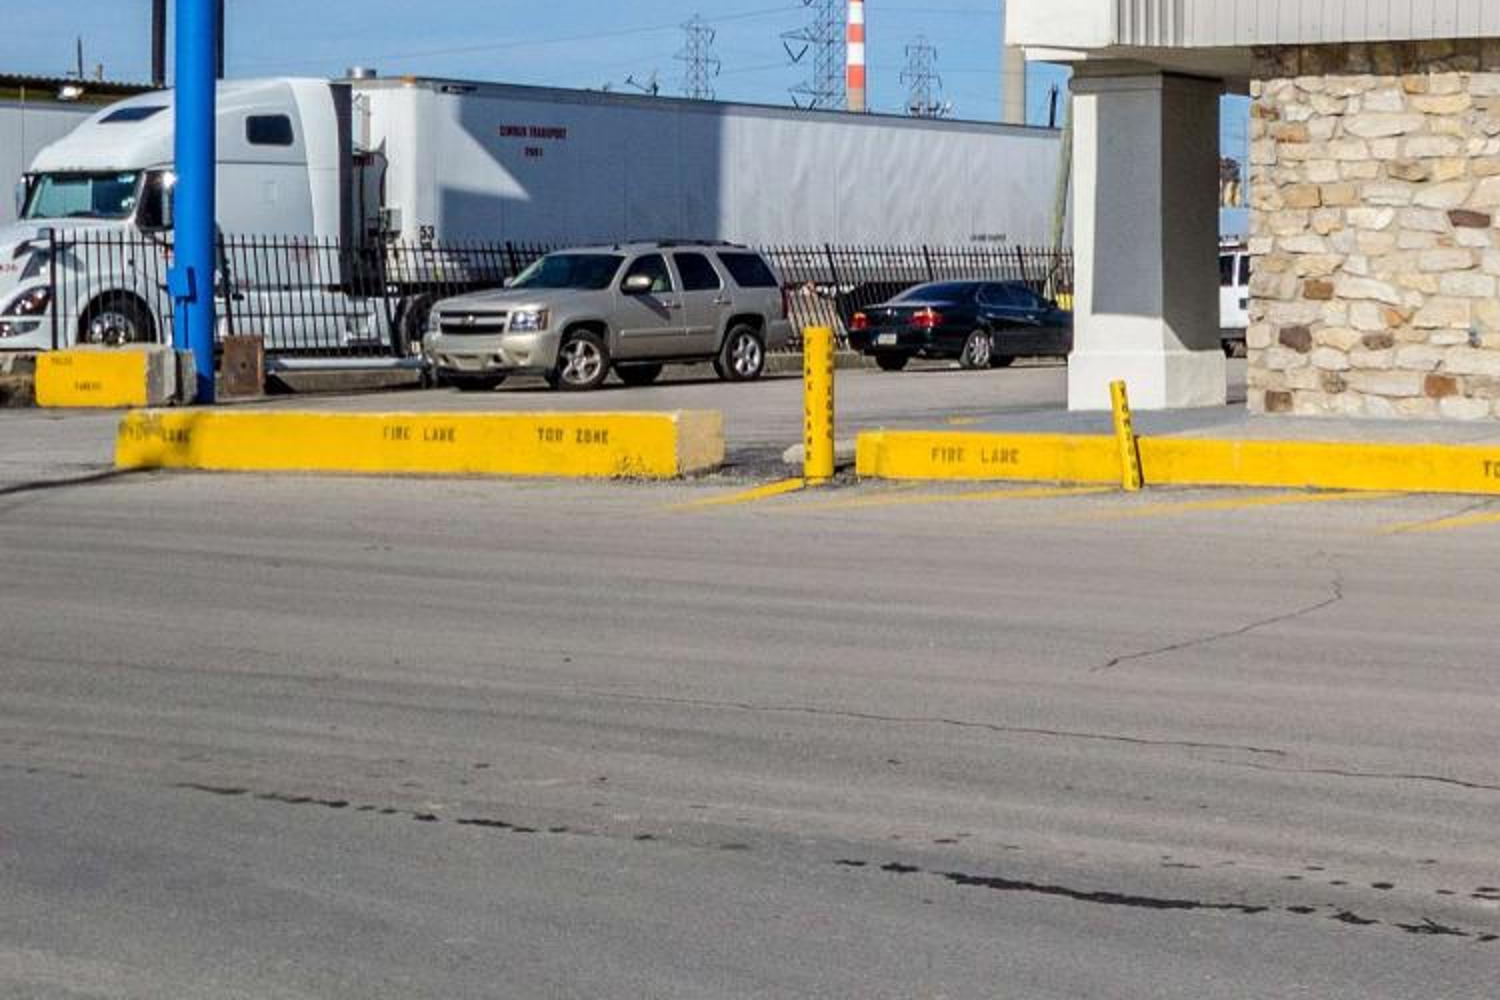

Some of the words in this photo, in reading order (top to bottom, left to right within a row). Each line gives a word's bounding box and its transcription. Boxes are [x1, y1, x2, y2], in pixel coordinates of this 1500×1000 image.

[419, 225, 435, 240] 53
[383, 426, 410, 441] FIRE
[423, 427, 455, 443] LANE
[537, 427, 563, 442] TOW
[575, 429, 609, 445] ZONE
[931, 446, 965, 464] FIRE
[980, 447, 1019, 465] LANE
